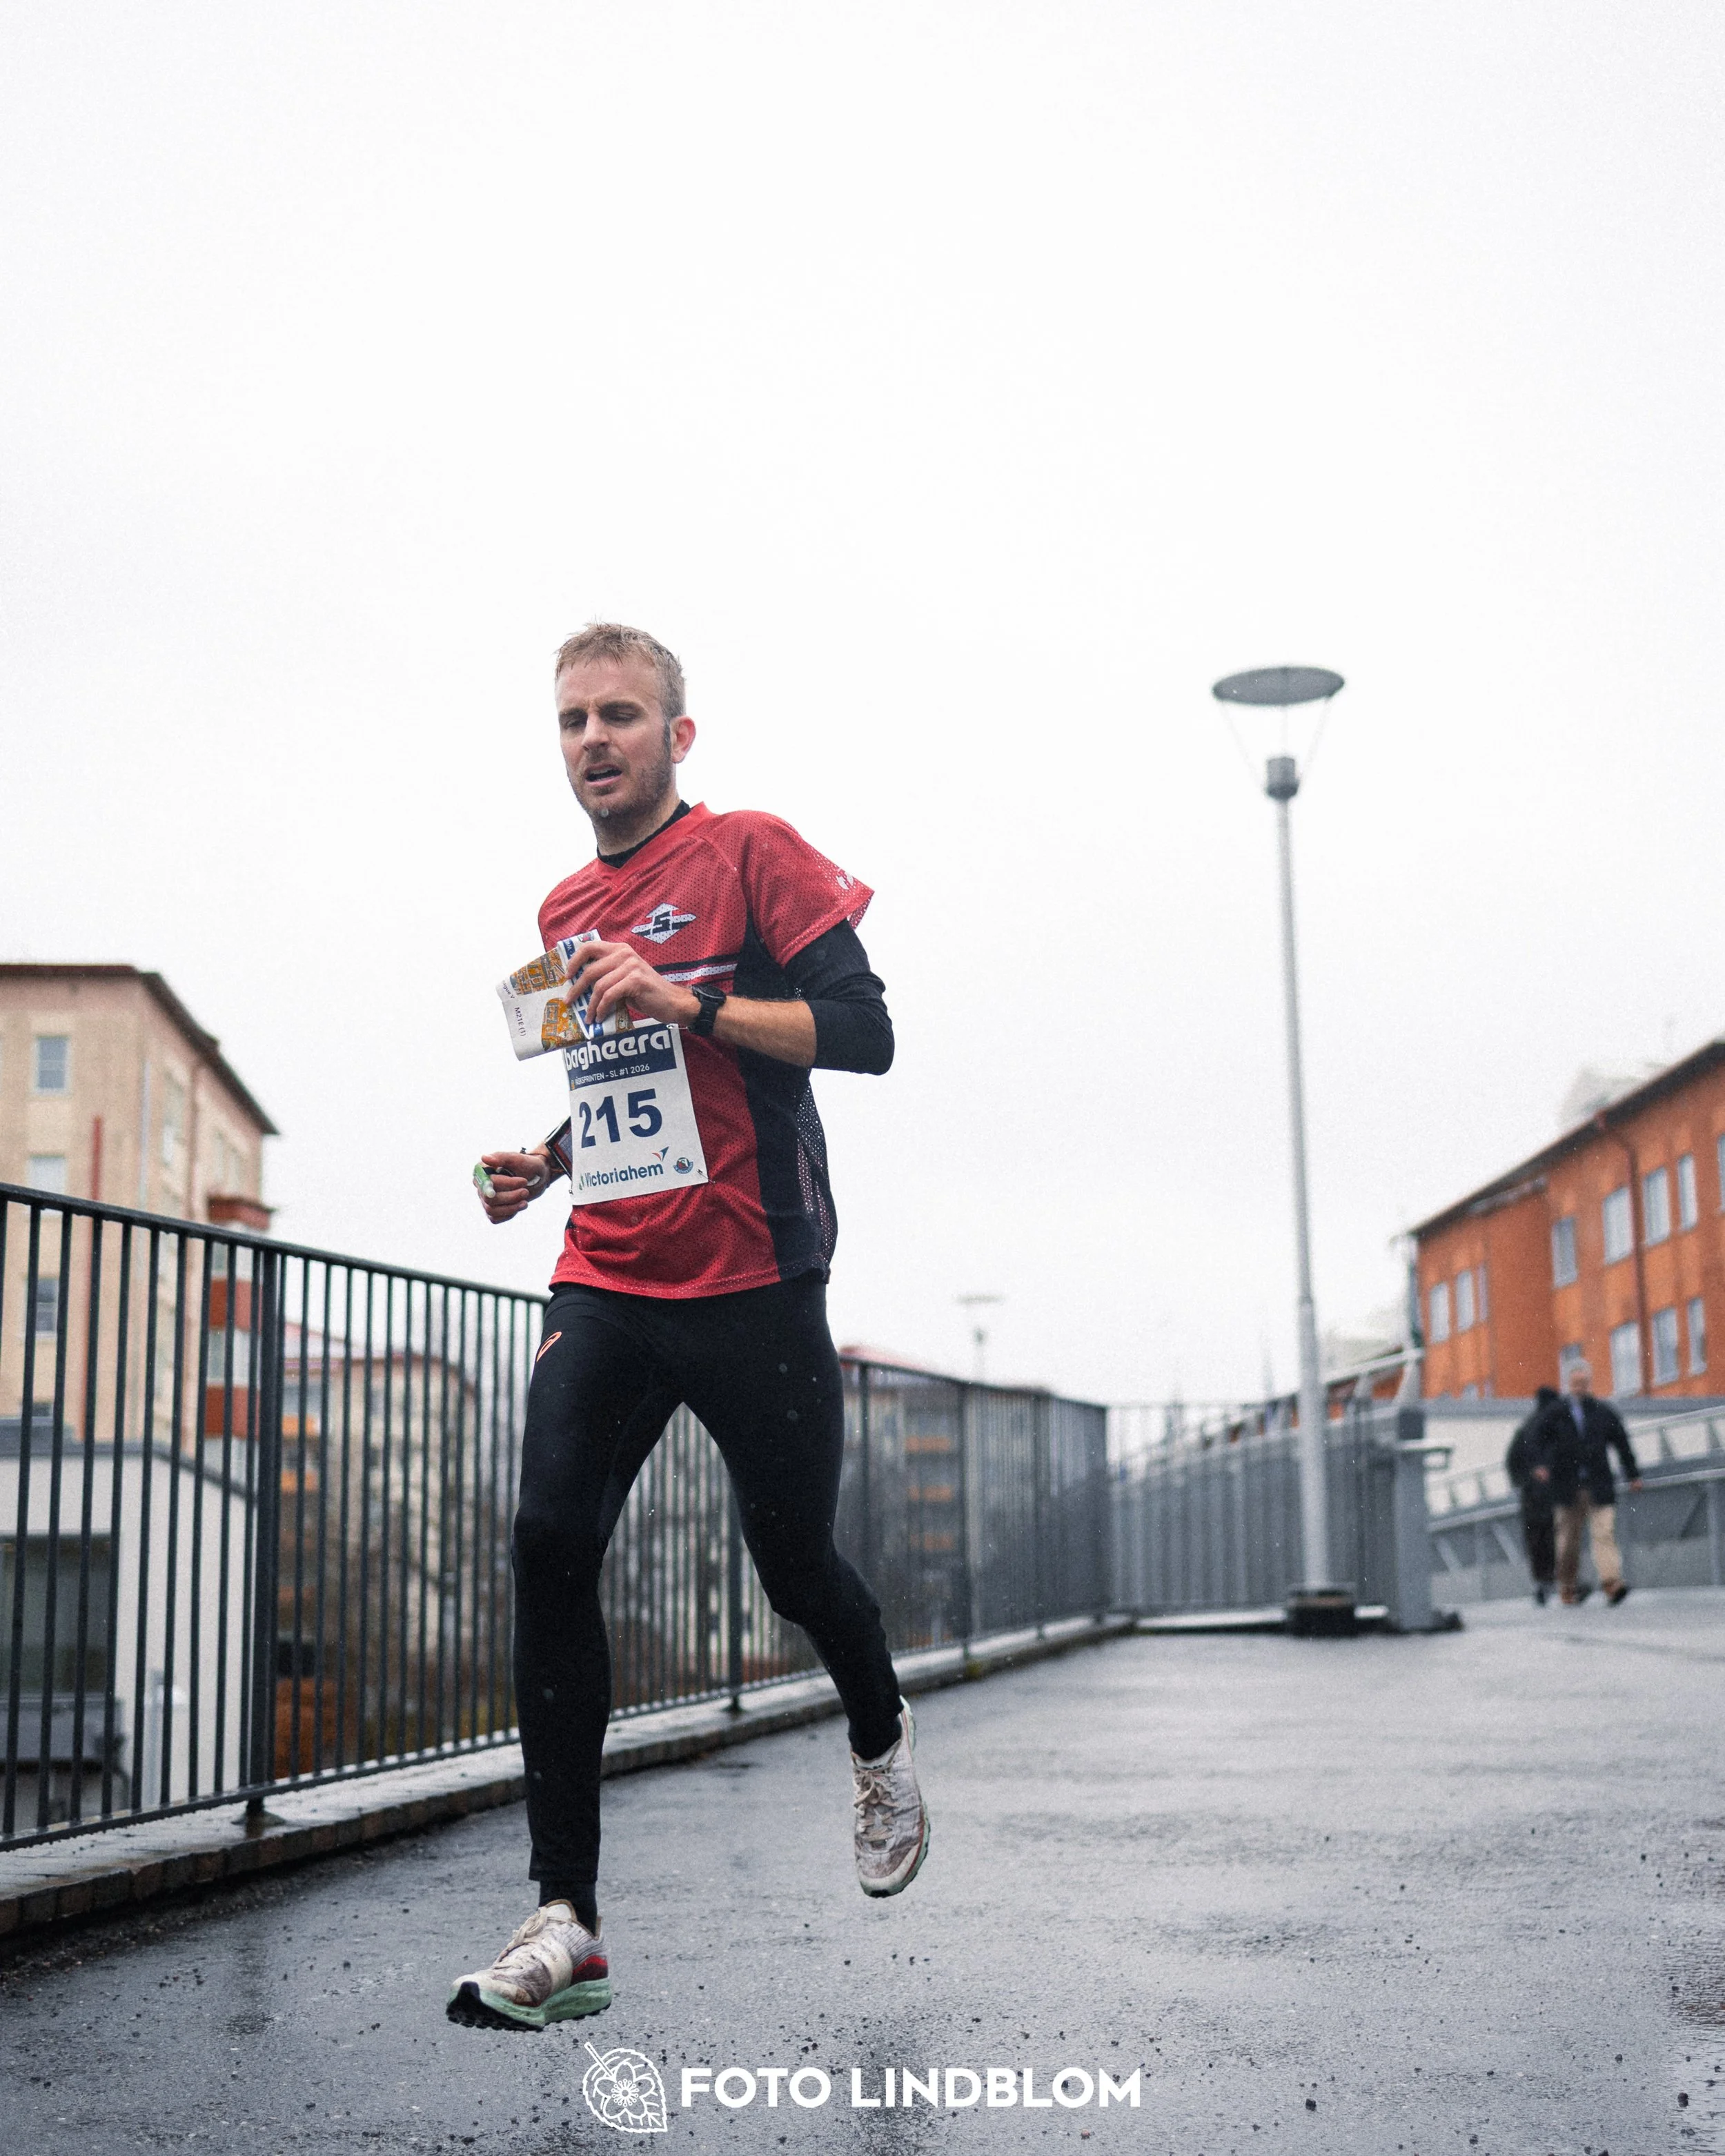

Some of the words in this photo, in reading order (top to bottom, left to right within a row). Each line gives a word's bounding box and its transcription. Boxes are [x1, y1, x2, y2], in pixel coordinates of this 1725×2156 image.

[514, 1007, 524, 1026] M21E
[564, 1030, 671, 1071] bagheera
[609, 1069, 619, 1078] SL
[620, 1067, 629, 1076] #1
[631, 1063, 650, 1074] 2026
[579, 1088, 662, 1148] 215
[584, 1163, 664, 1187] Victoriahem
